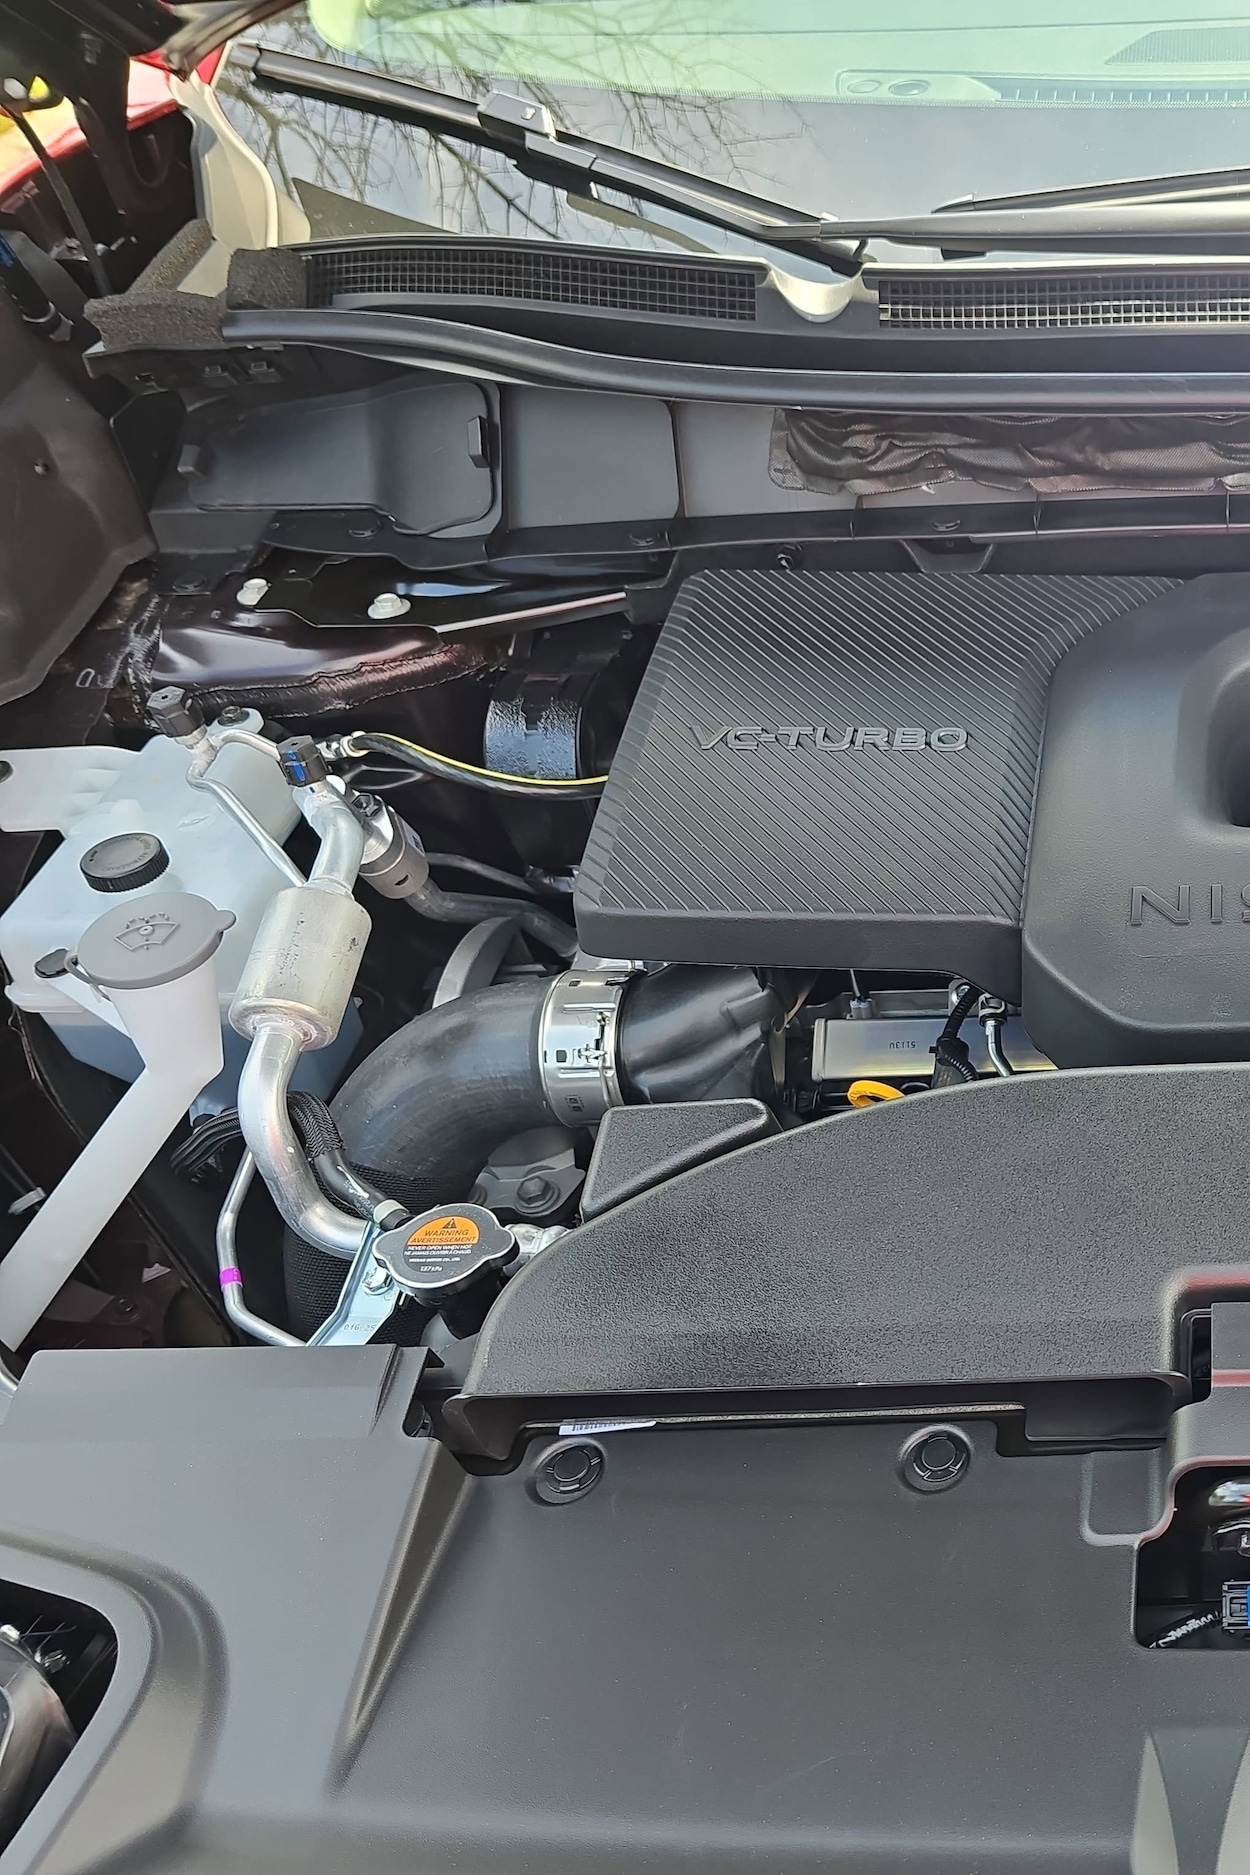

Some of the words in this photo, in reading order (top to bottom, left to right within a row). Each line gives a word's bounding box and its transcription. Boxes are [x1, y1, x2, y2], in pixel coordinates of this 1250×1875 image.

[690, 725, 969, 751] VC-TURBO
[424, 1229, 470, 1237] WARNING
[410, 1236, 477, 1244] AVERTISSEMENT
